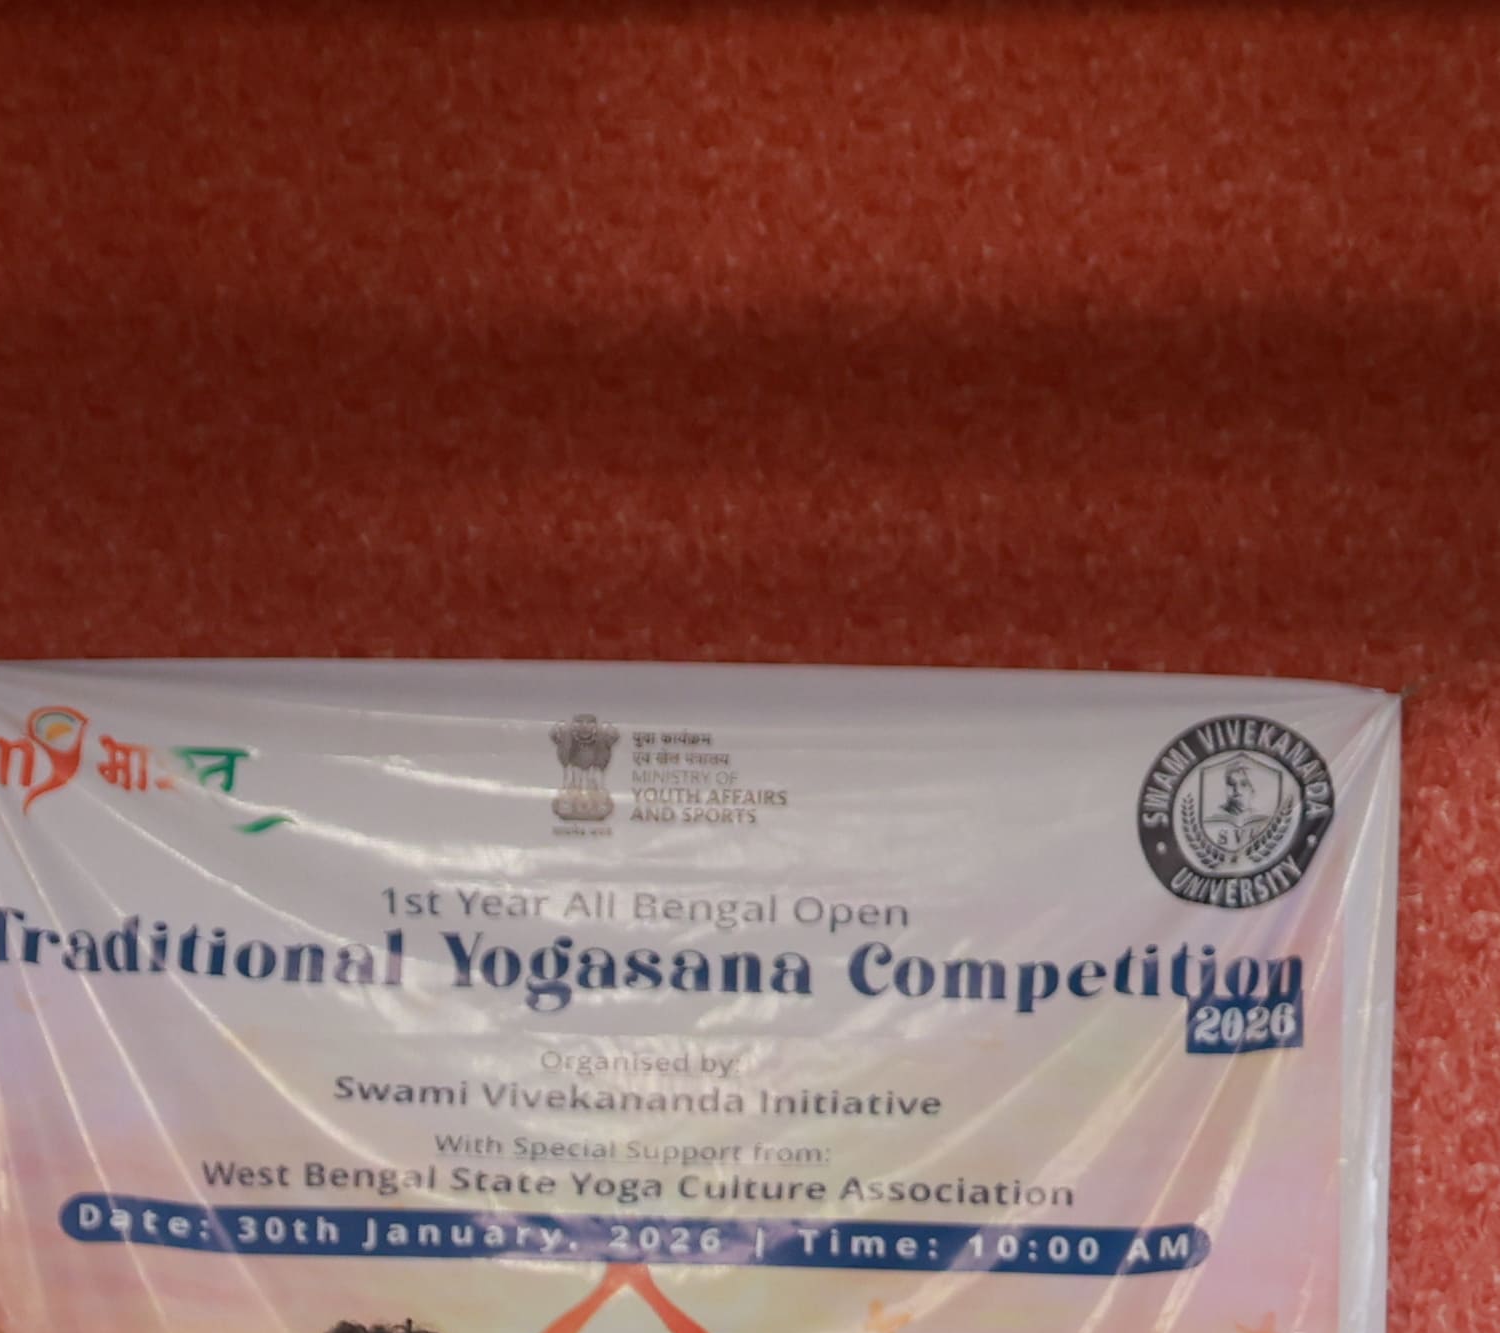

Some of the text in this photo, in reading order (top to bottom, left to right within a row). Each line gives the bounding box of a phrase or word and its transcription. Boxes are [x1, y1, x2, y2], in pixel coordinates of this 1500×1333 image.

[632, 770, 739, 785] MINISTRY OF
[632, 787, 788, 806] YOUTH AFFAIRS
[1143, 739, 1197, 828] SWAMI
[630, 807, 757, 824] AND SPORTS
[1171, 854, 1302, 907] UNIVERSITY
[381, 887, 909, 932] 1st Year All Bengal Open
[441, 930, 813, 1011] Yogasana
[848, 941, 1304, 1012] Competition
[1193, 1003, 1296, 1044] 2026
[541, 1051, 740, 1077] Organised by:
[334, 1076, 942, 1116] Swami Vivekananda Initiative
[434, 1135, 830, 1166] With Special Support from:
[202, 1160, 1075, 1208] West Bengal State Yoga Culture Association
[78, 1202, 210, 1240] Date:
[238, 1216, 340, 1245] 30th
[610, 1226, 721, 1252] 2026
[798, 1228, 939, 1260] Time:
[968, 1233, 1100, 1263] 10:00
[1126, 1233, 1190, 1264] AM
